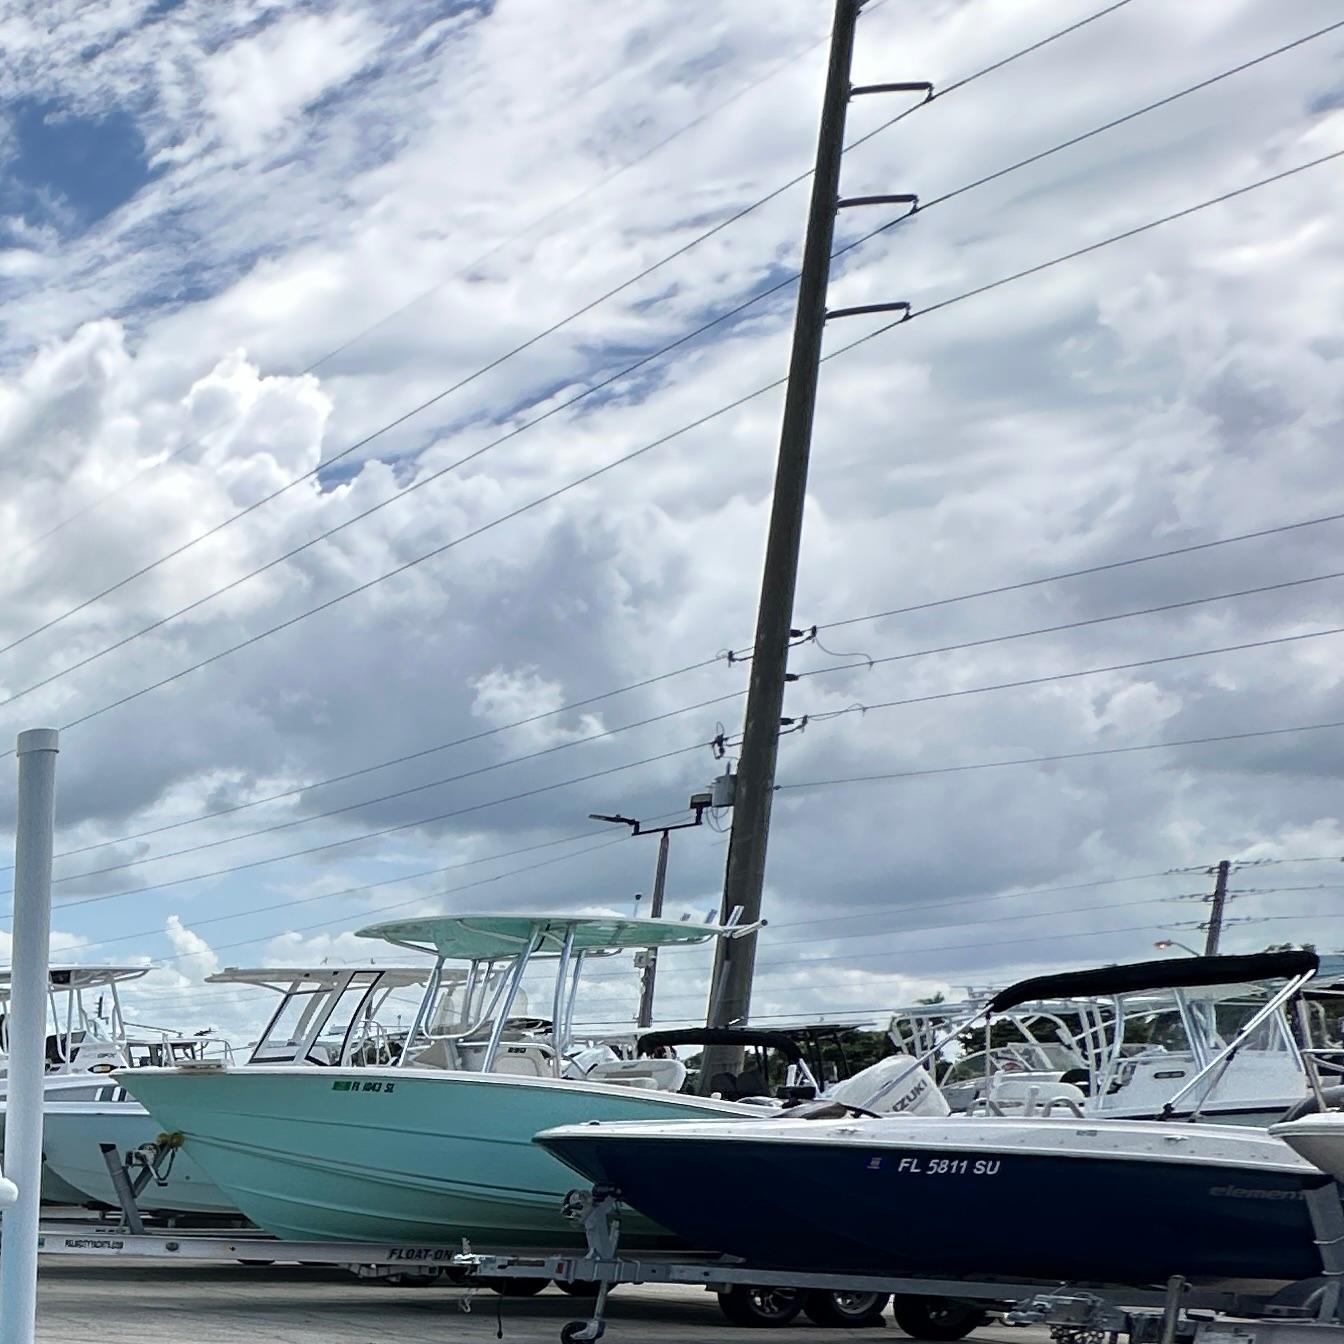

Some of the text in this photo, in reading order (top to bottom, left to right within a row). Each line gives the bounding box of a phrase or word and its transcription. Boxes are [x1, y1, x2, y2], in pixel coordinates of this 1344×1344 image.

[898, 1158, 921, 1173] FL
[926, 1159, 968, 1174] 5811
[973, 1160, 1001, 1175] SU
